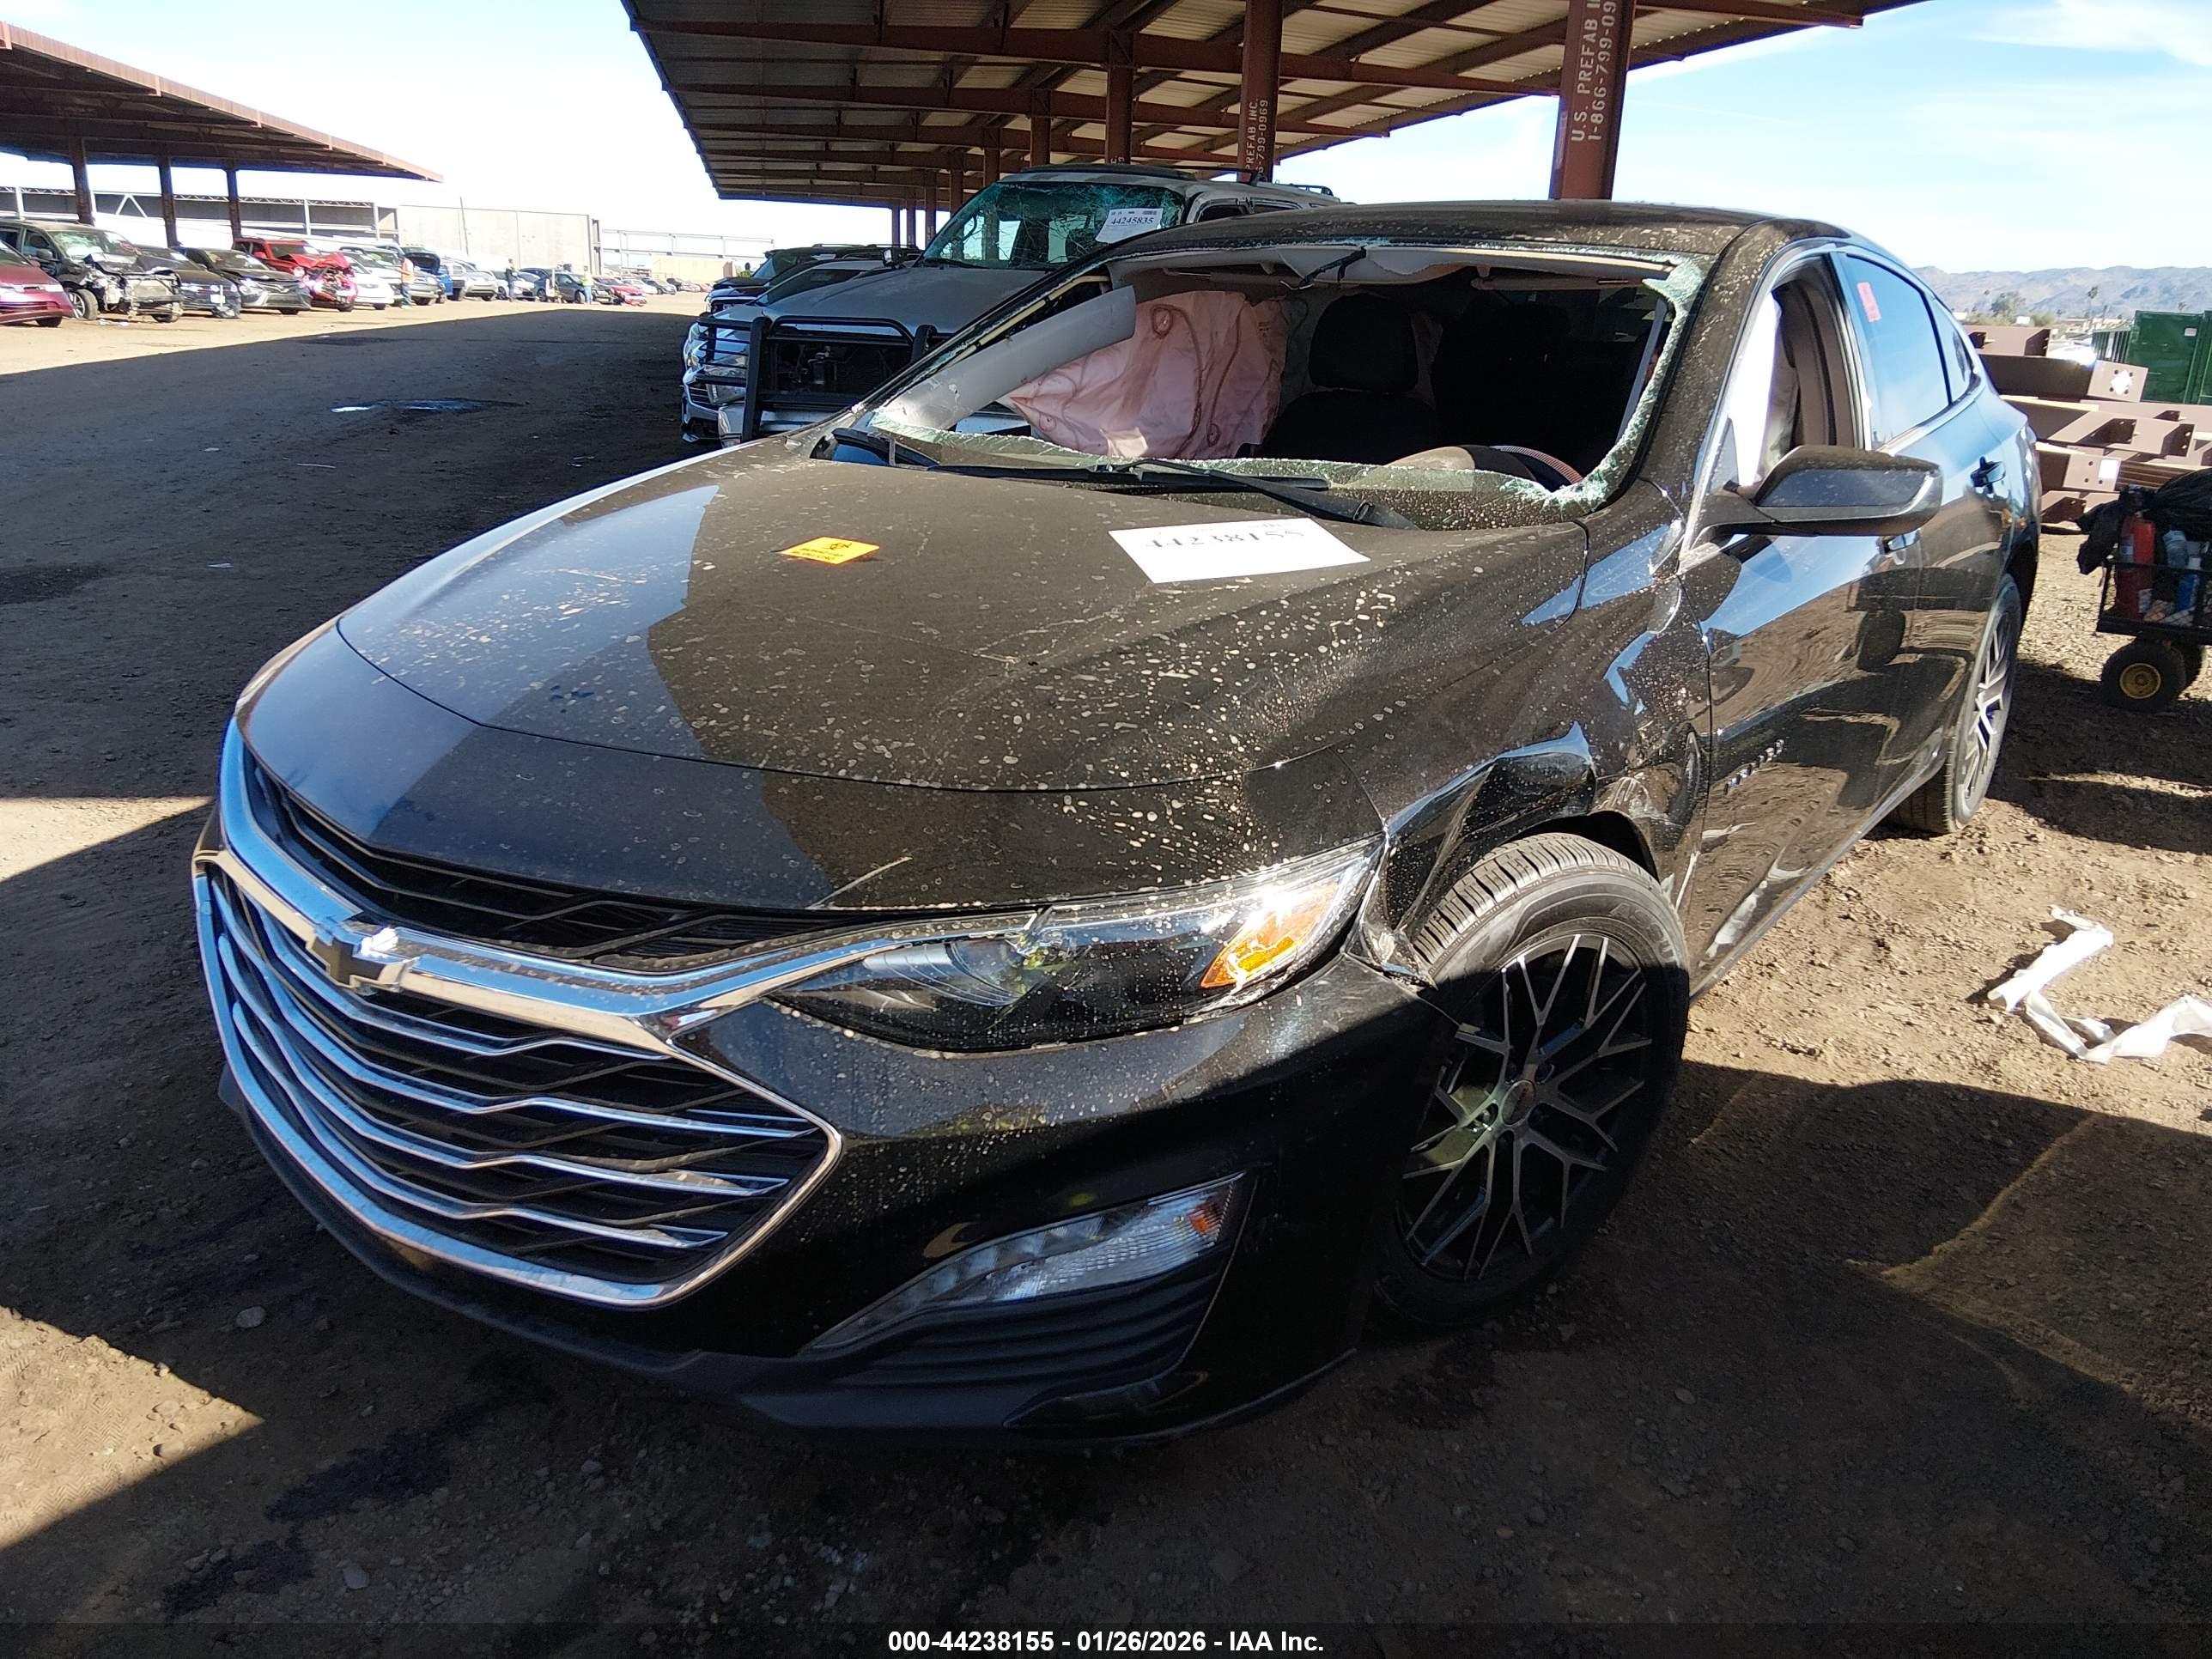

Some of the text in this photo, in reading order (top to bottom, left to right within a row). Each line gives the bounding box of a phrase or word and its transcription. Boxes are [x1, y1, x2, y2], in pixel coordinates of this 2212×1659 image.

[1577, 18, 1598, 94] PREFAB
[1249, 98, 1259, 120] INC.
[1571, 105, 1589, 142] U.S.
[1110, 216, 1155, 225] 44245835
